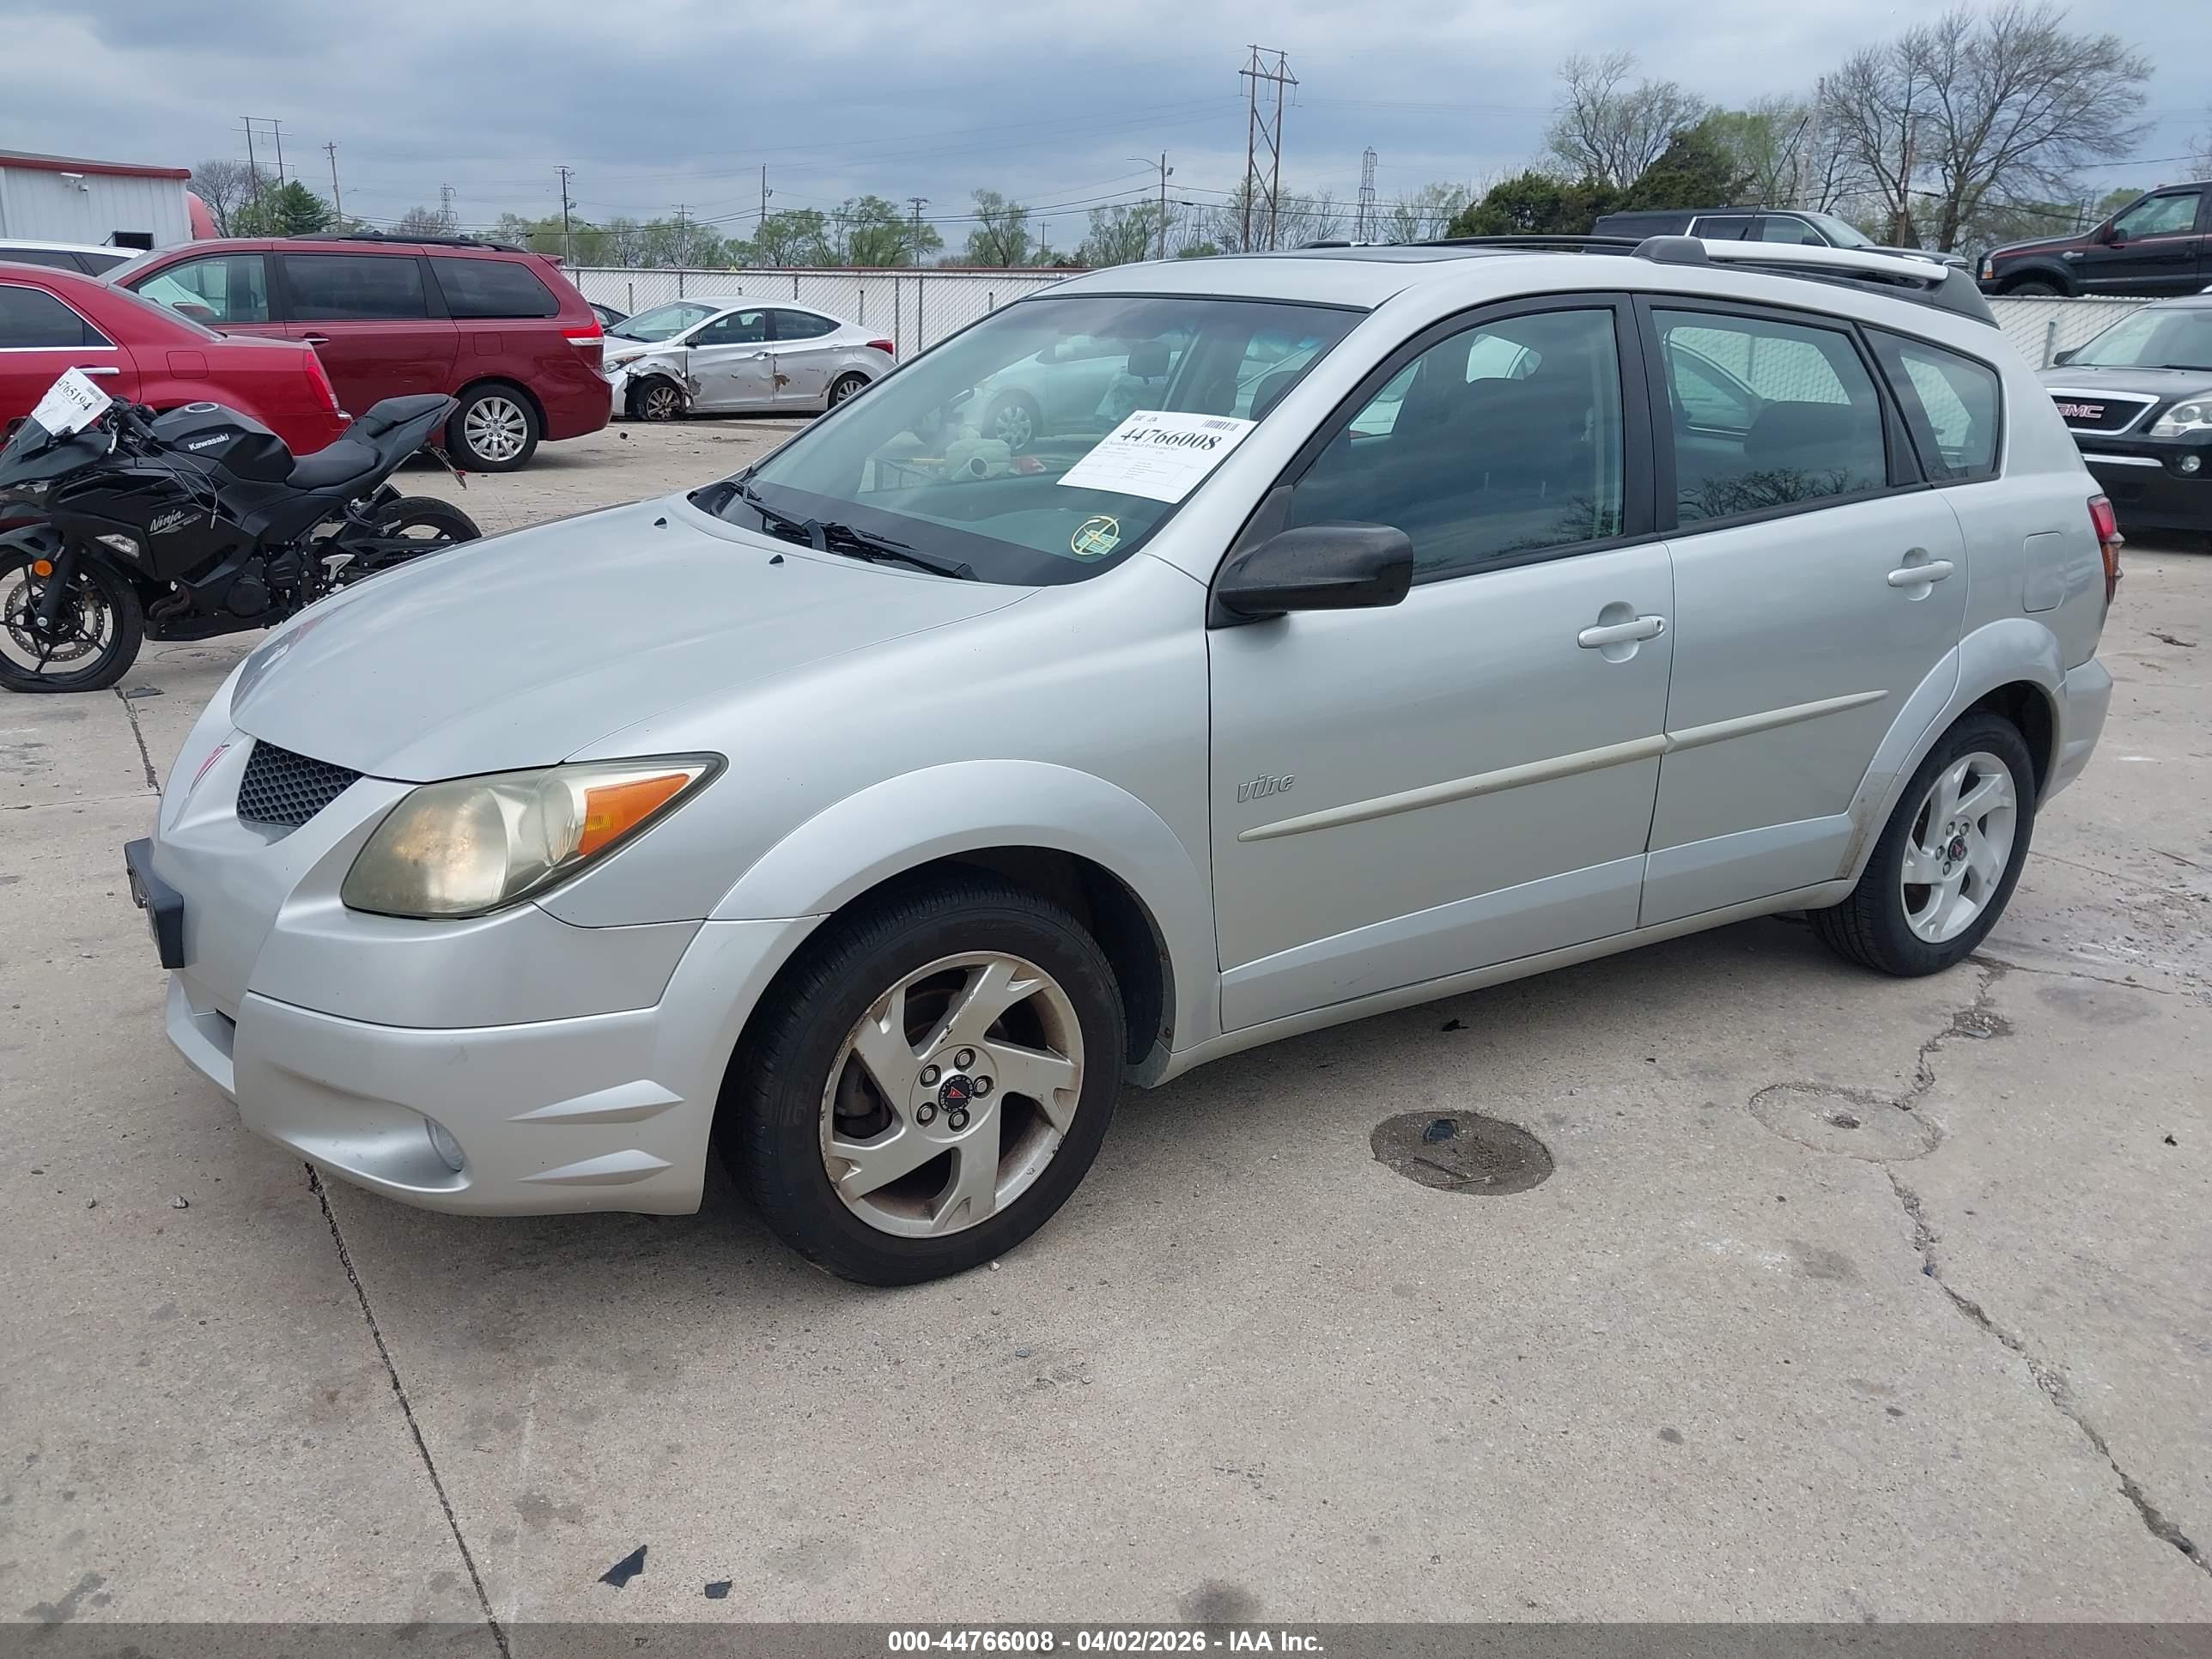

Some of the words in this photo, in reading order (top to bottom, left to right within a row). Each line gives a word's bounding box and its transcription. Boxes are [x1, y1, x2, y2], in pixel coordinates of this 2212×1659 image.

[188, 433, 229, 451] Kawasaki
[1121, 428, 1222, 450] 44766008
[149, 509, 185, 532] Ninja
[1237, 774, 1295, 804] vibe
